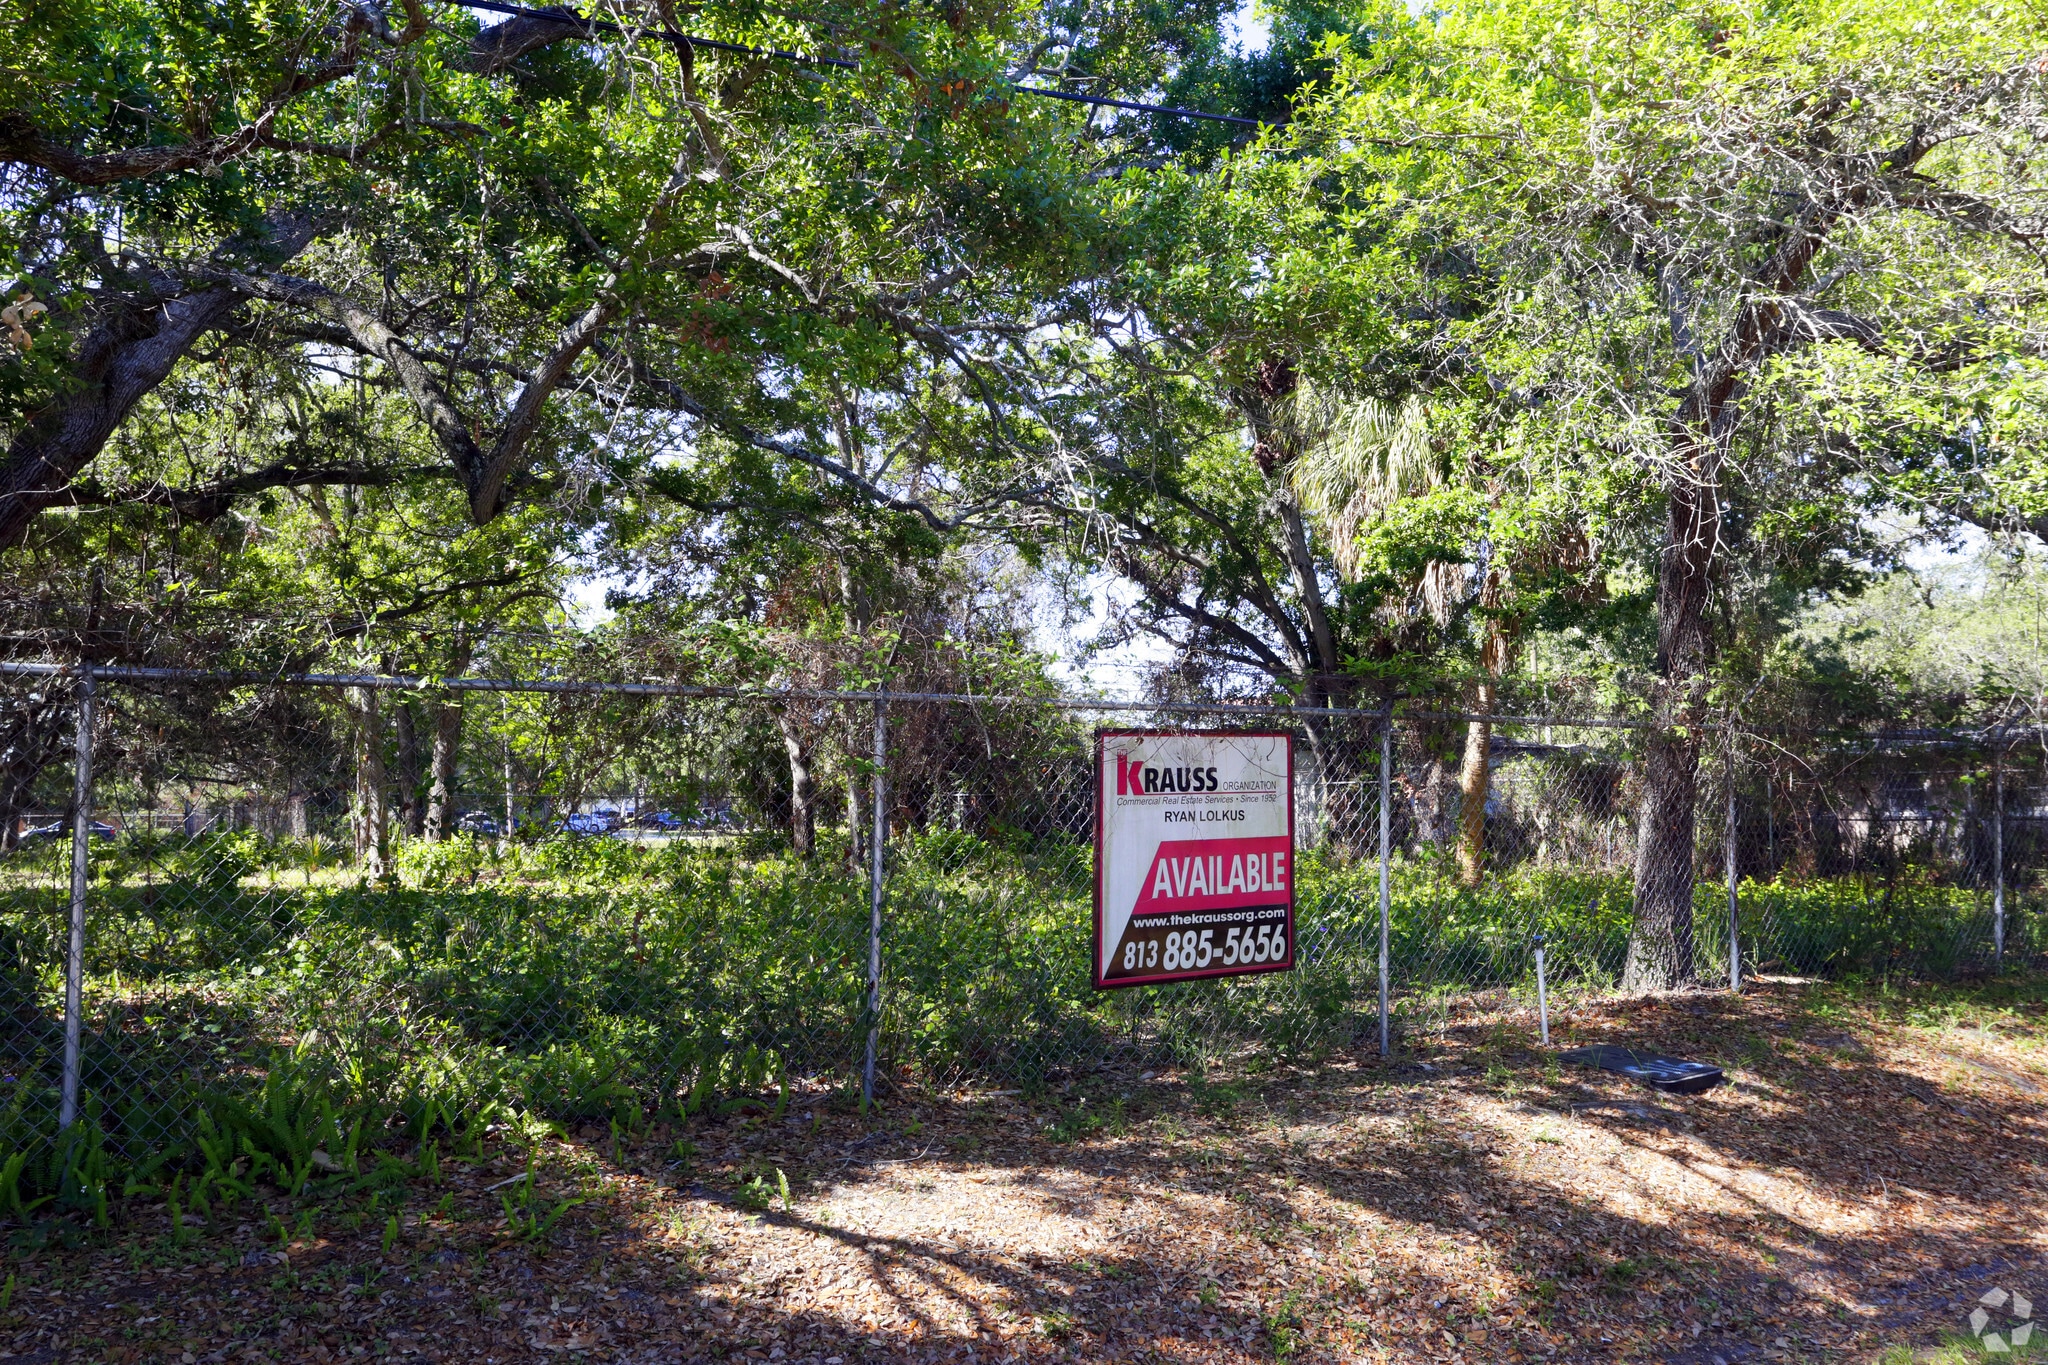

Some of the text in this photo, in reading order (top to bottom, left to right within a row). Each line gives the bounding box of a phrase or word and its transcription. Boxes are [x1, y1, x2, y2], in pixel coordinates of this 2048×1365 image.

[1117, 750, 1277, 796] KRAUSS ORGANIZATION
[1117, 796, 1160, 806] Commercial
[1162, 795, 1179, 805] Real
[1181, 795, 1203, 805] Estate
[1205, 795, 1234, 804] Services
[1240, 794, 1259, 803] Since
[1164, 809, 1245, 823] RYAN LOLKUS
[1152, 852, 1285, 899] AVAILABLE
[1133, 908, 1285, 928] www.thekraussorg.com
[1123, 924, 1286, 971] 813 885-5656
